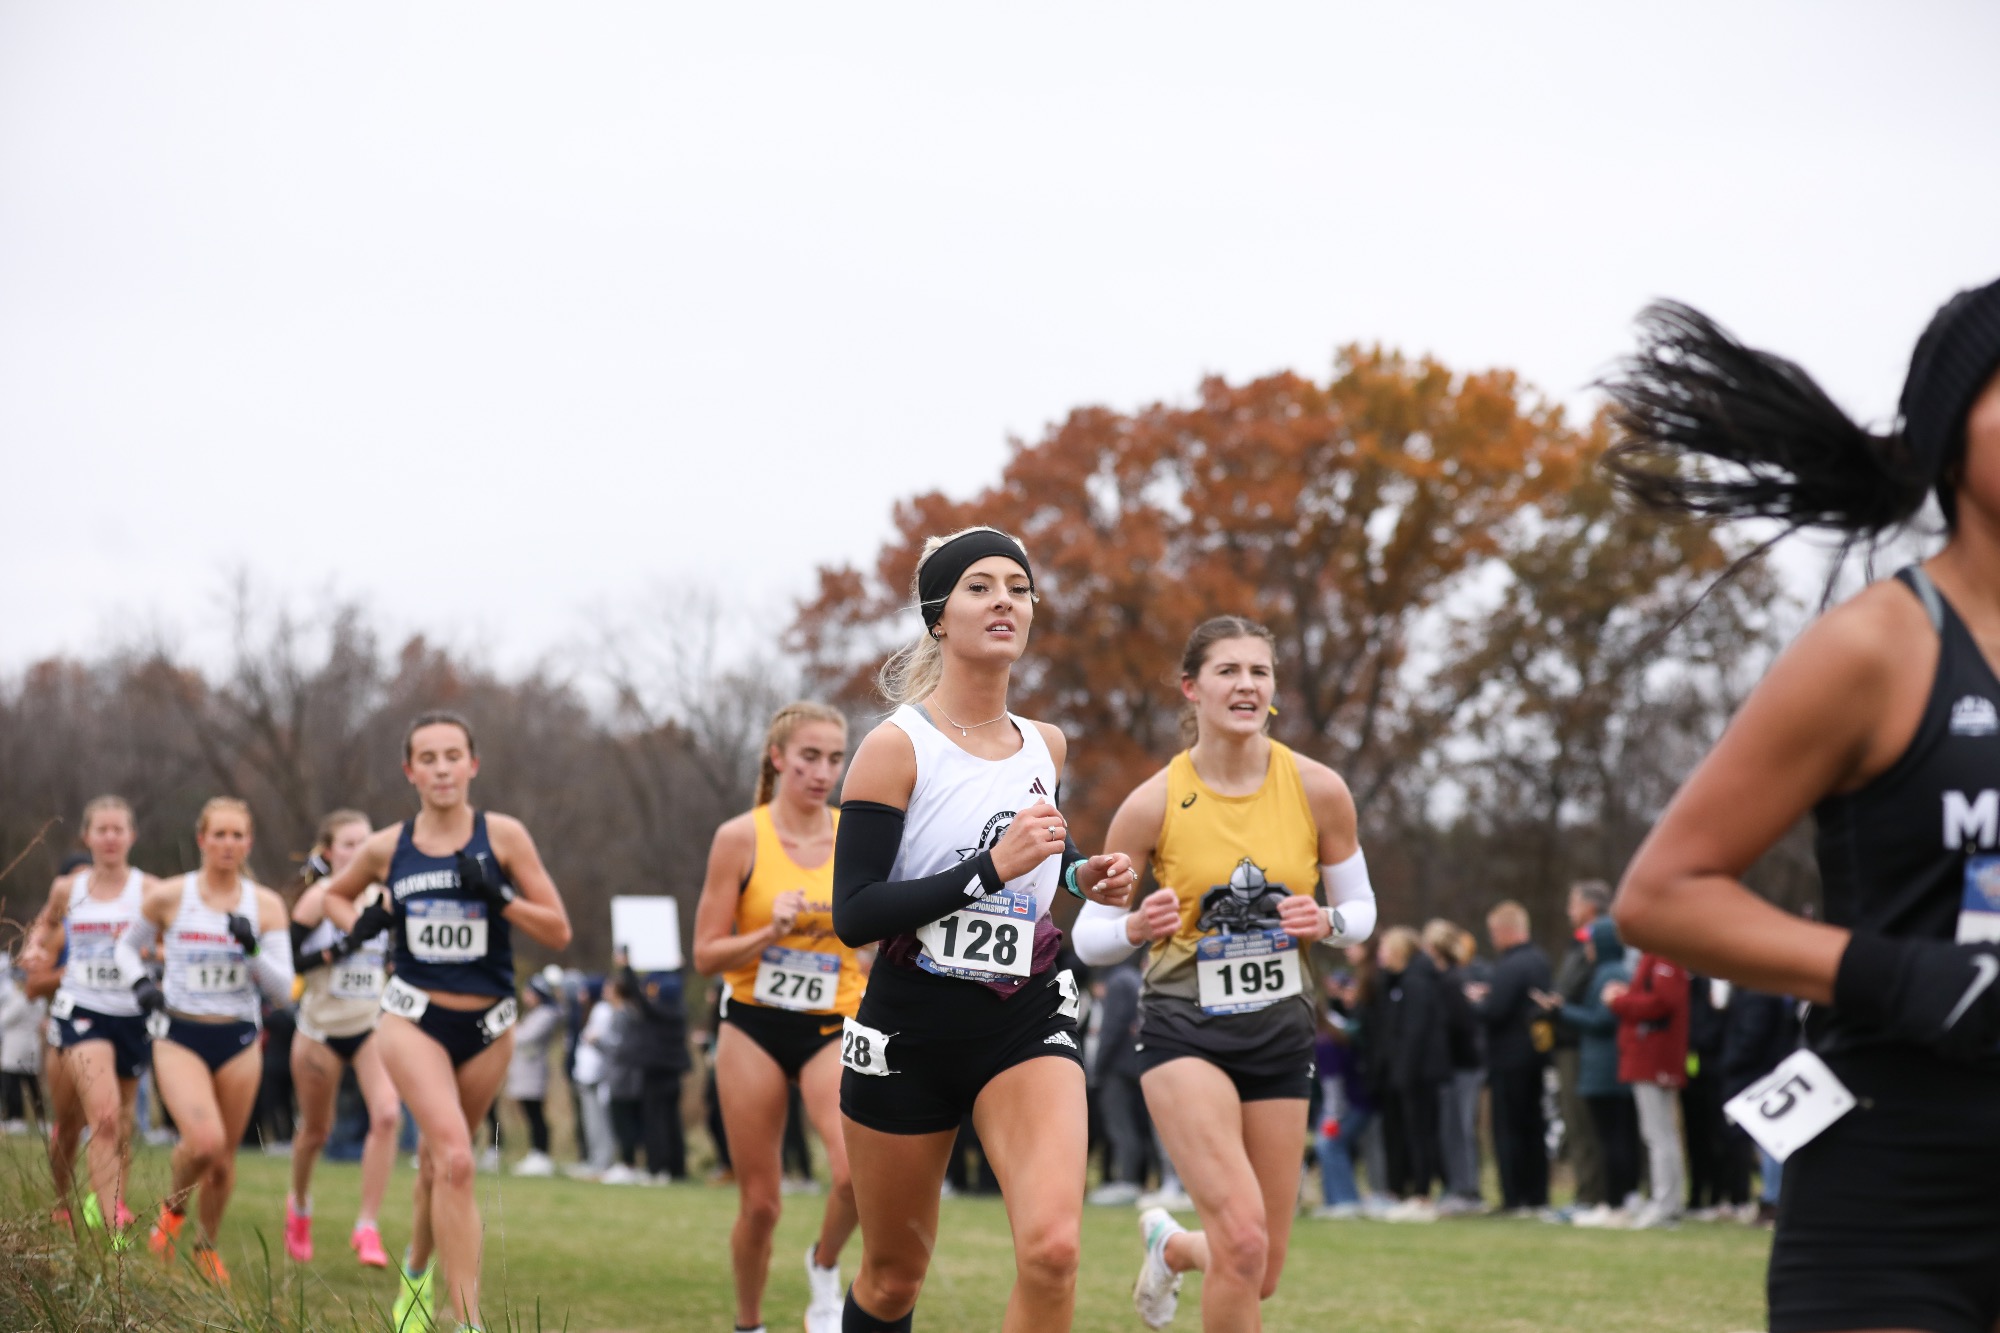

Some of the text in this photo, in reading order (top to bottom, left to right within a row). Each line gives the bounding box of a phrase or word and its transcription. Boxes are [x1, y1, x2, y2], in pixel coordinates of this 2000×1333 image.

[980, 812, 1015, 842] CAMPBELL
[1940, 788, 2000, 851] M
[393, 869, 455, 901] SHAWNEE
[965, 901, 1010, 915] MPIONSHIPS
[418, 923, 473, 949] 400
[939, 915, 1019, 966] 128
[199, 967, 237, 985] 174
[769, 970, 824, 1003] 276
[1217, 959, 1285, 996] 195
[842, 1030, 872, 1068] 28
[1043, 1037, 1078, 1050] adidas
[1748, 1073, 1812, 1120] 5
